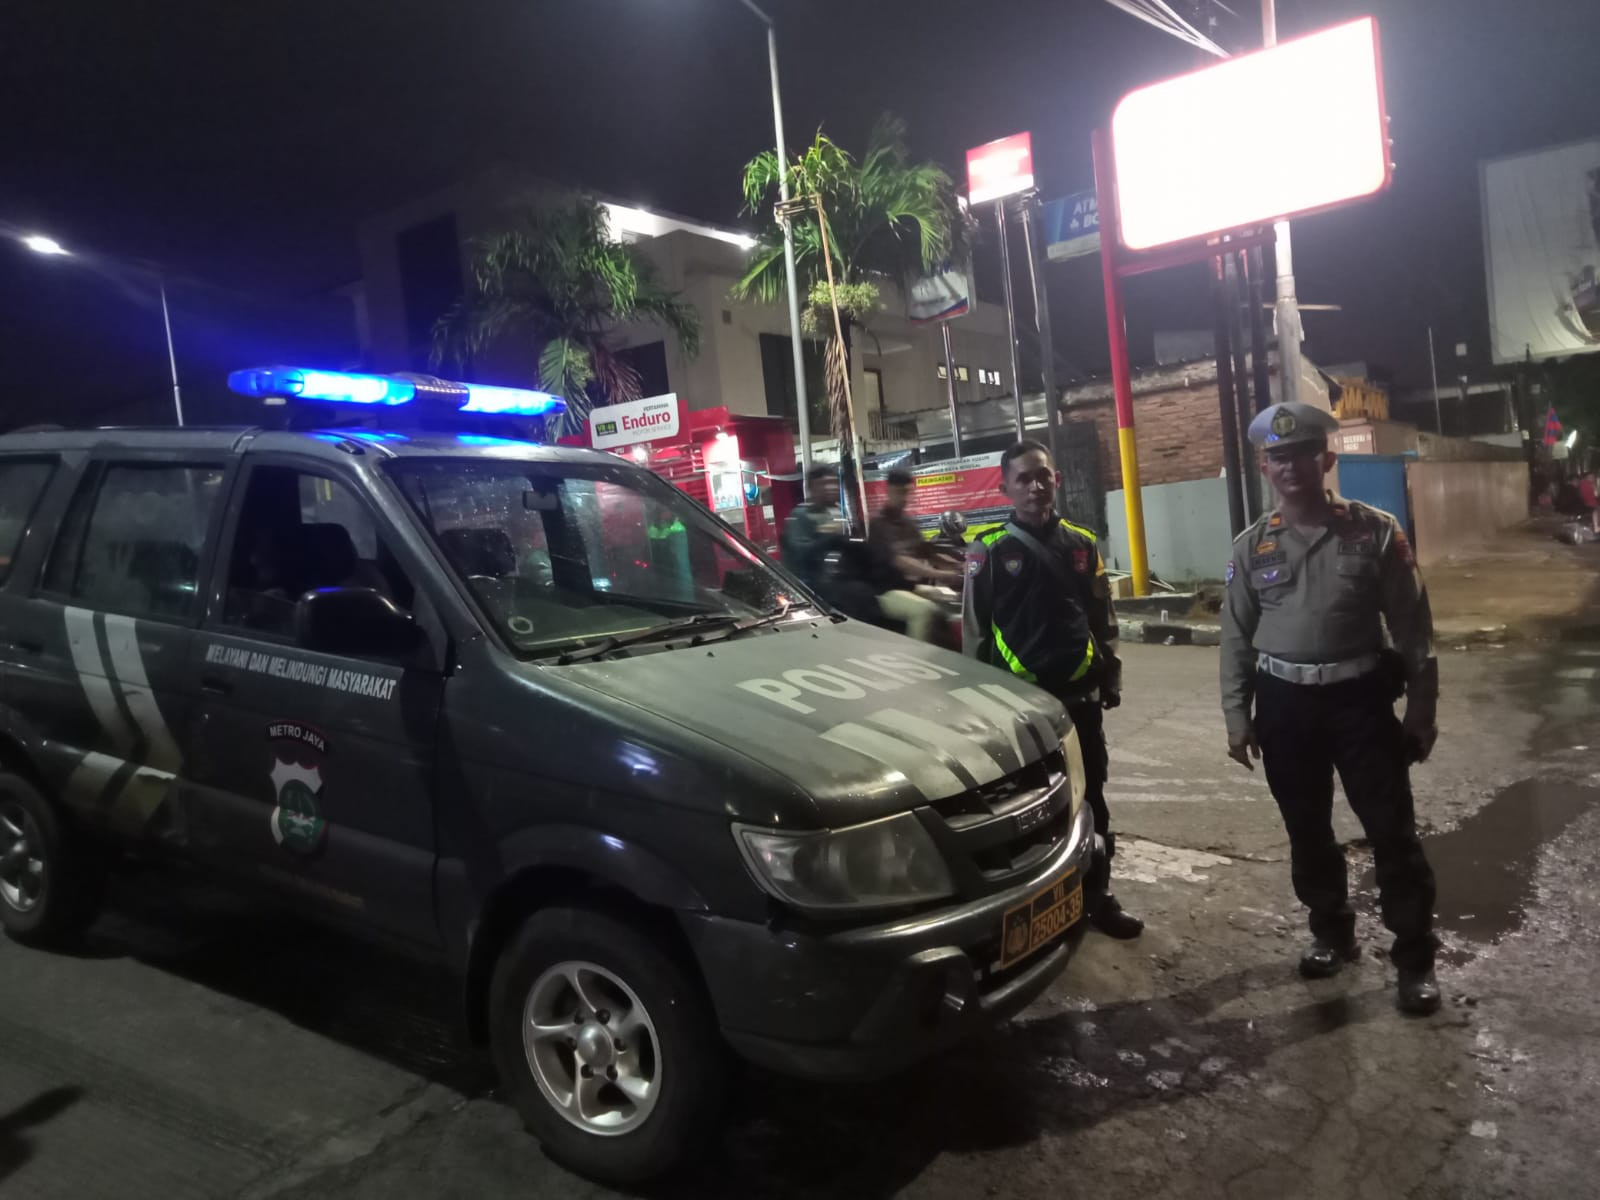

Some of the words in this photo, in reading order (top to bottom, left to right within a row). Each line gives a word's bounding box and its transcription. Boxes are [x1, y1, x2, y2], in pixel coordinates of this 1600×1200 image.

[621, 411, 671, 431] Enduro
[248, 651, 270, 673] DAN
[267, 656, 328, 687] MELINDUNGI
[326, 668, 397, 700] MASYARAKAT
[735, 651, 961, 715] POLISI
[269, 724, 301, 738] METRO
[302, 730, 325, 751] JAYA
